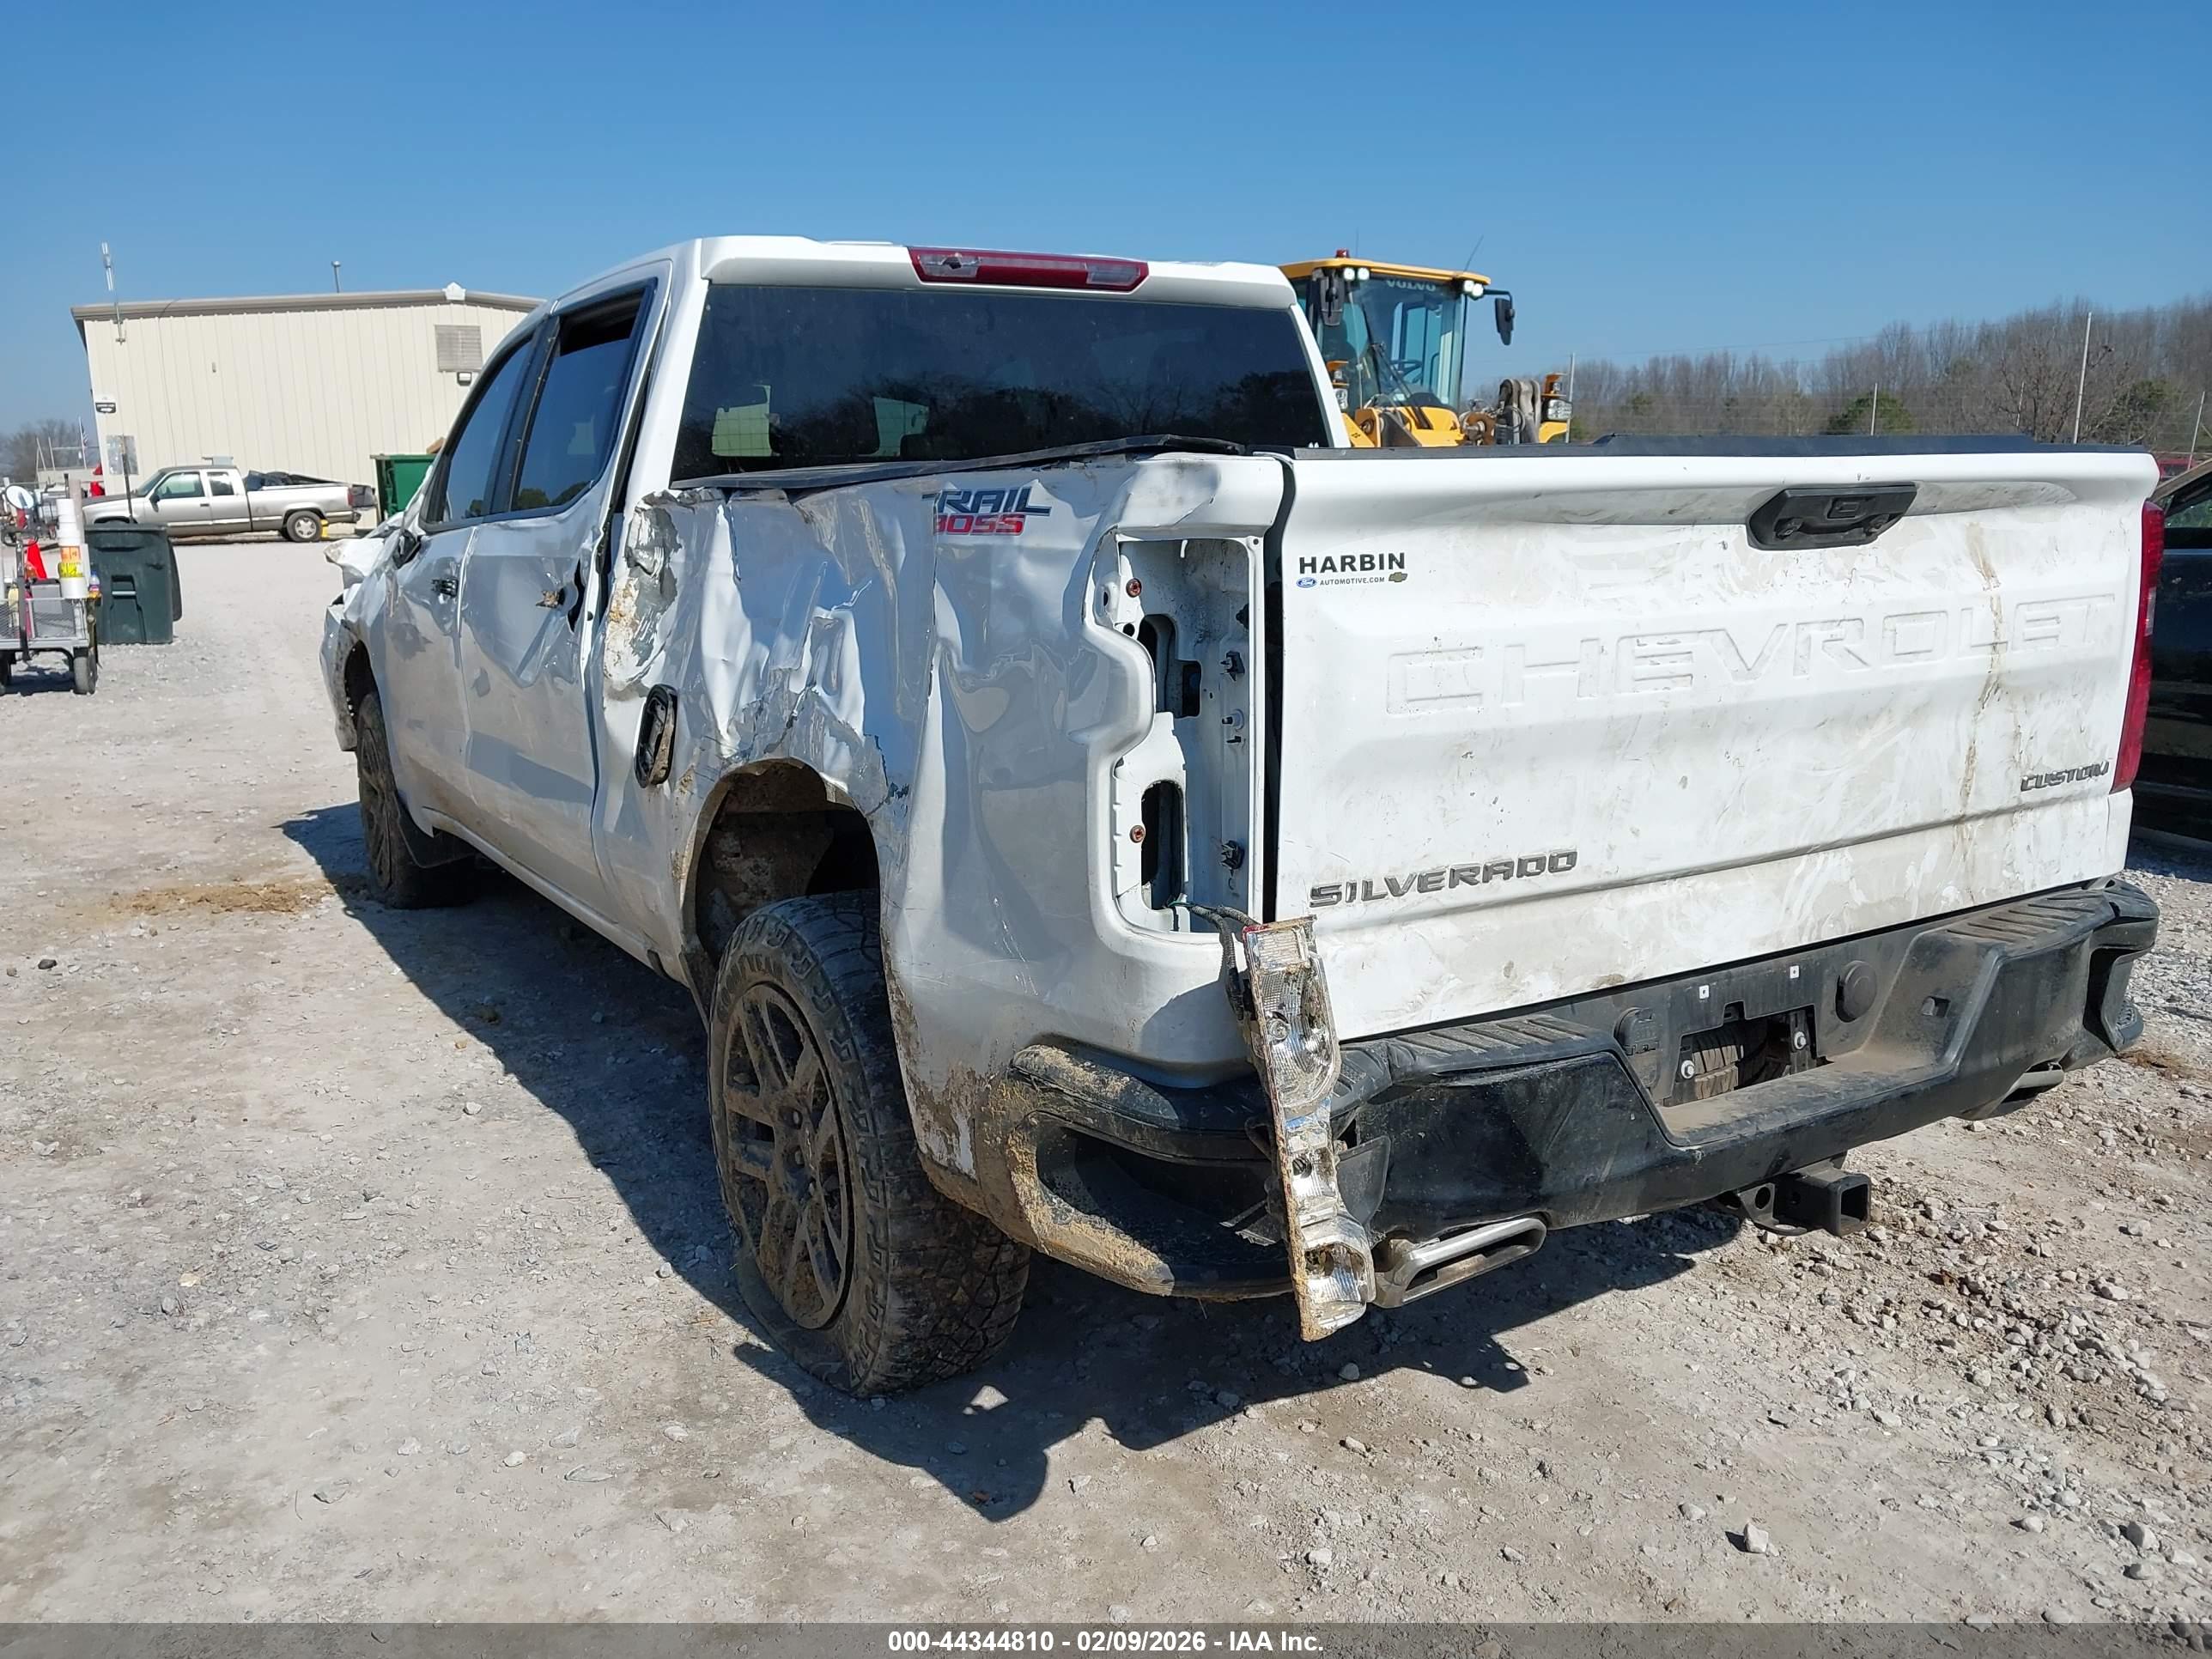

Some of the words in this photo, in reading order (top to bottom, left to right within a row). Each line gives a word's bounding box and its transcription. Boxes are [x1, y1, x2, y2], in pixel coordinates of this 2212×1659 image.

[1387, 279, 1437, 292] VOLVO
[1299, 552, 1405, 574] HARBIN
[1320, 576, 1385, 586] AUTOMOTIVE.COM
[1386, 593, 2115, 714] CHEVROLET
[2021, 761, 2110, 792] CUSTOM
[1309, 850, 1578, 908] SILVERADO
